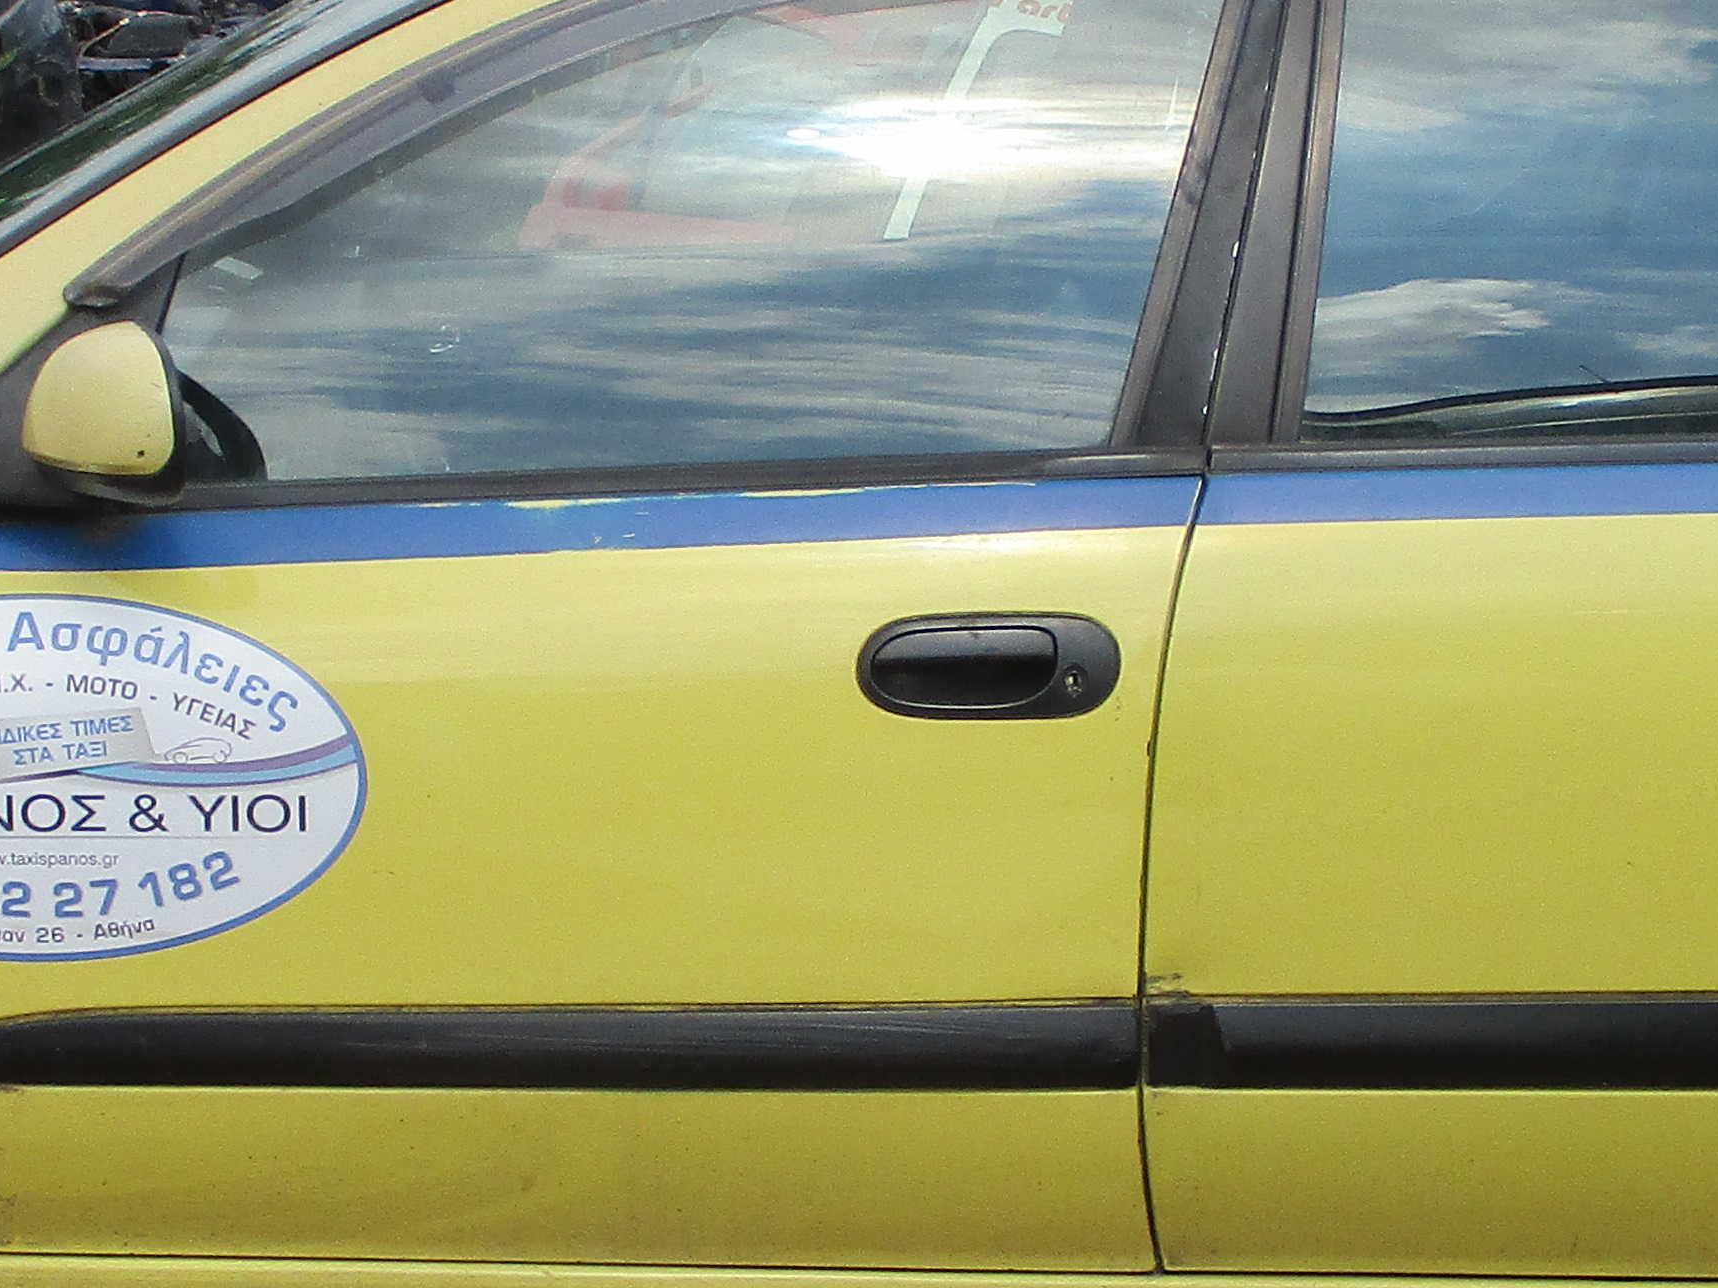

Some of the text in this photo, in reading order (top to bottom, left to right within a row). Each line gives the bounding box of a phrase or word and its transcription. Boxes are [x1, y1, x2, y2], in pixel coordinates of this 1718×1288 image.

[7, 611, 299, 732] Ασφάλειες
[66, 674, 138, 701] ΜΟΤΟ
[172, 692, 257, 740] ΥΓΕΙΑΣ
[70, 715, 133, 737] ΤΙΜΕΣ
[13, 740, 107, 766] ΣΤΑ ΤΑΞΙ
[128, 793, 169, 833] &
[188, 793, 307, 833] ΥΙΟΙ
[53, 878, 118, 918] 27
[138, 850, 240, 907] 182
[36, 926, 65, 944] 26
[93, 918, 155, 942] Αθήνα
